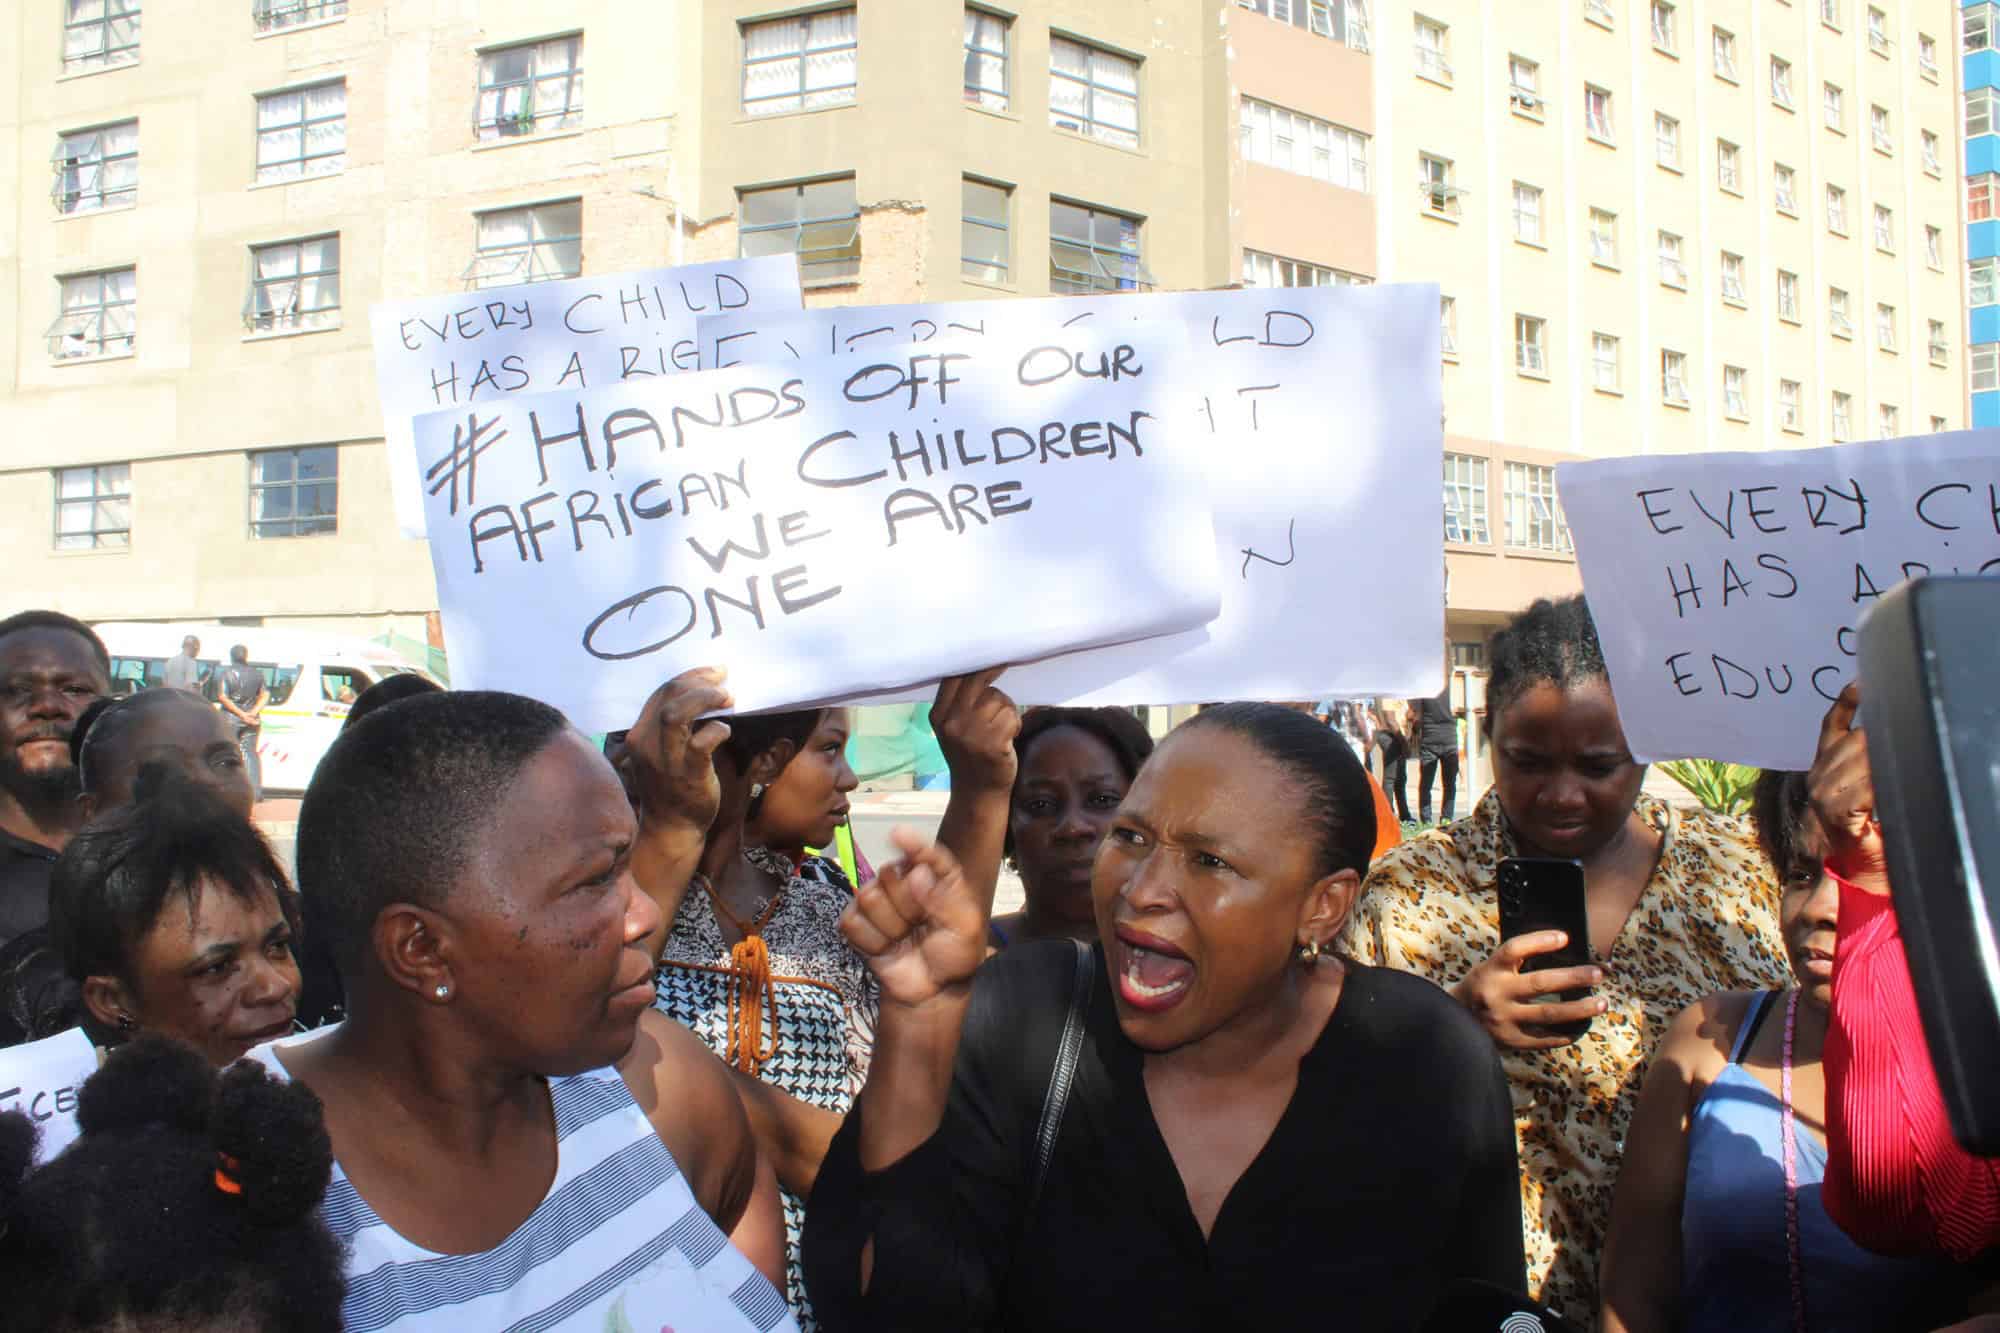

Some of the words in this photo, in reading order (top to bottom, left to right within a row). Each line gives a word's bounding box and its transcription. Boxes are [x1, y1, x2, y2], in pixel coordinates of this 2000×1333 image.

[564, 273, 750, 334] CHILD
[431, 355, 530, 404] HAS
[558, 352, 586, 387] A
[842, 352, 972, 411] OFF
[1017, 341, 1144, 386] OUR
[687, 511, 832, 573] WE
[884, 482, 1032, 547] ARE
[1637, 478, 1869, 538] EVERY
[582, 564, 843, 660] ONE
[1666, 553, 1798, 618] HAS
[1852, 563, 1886, 602] A
[1665, 651, 1841, 702] EDUC
